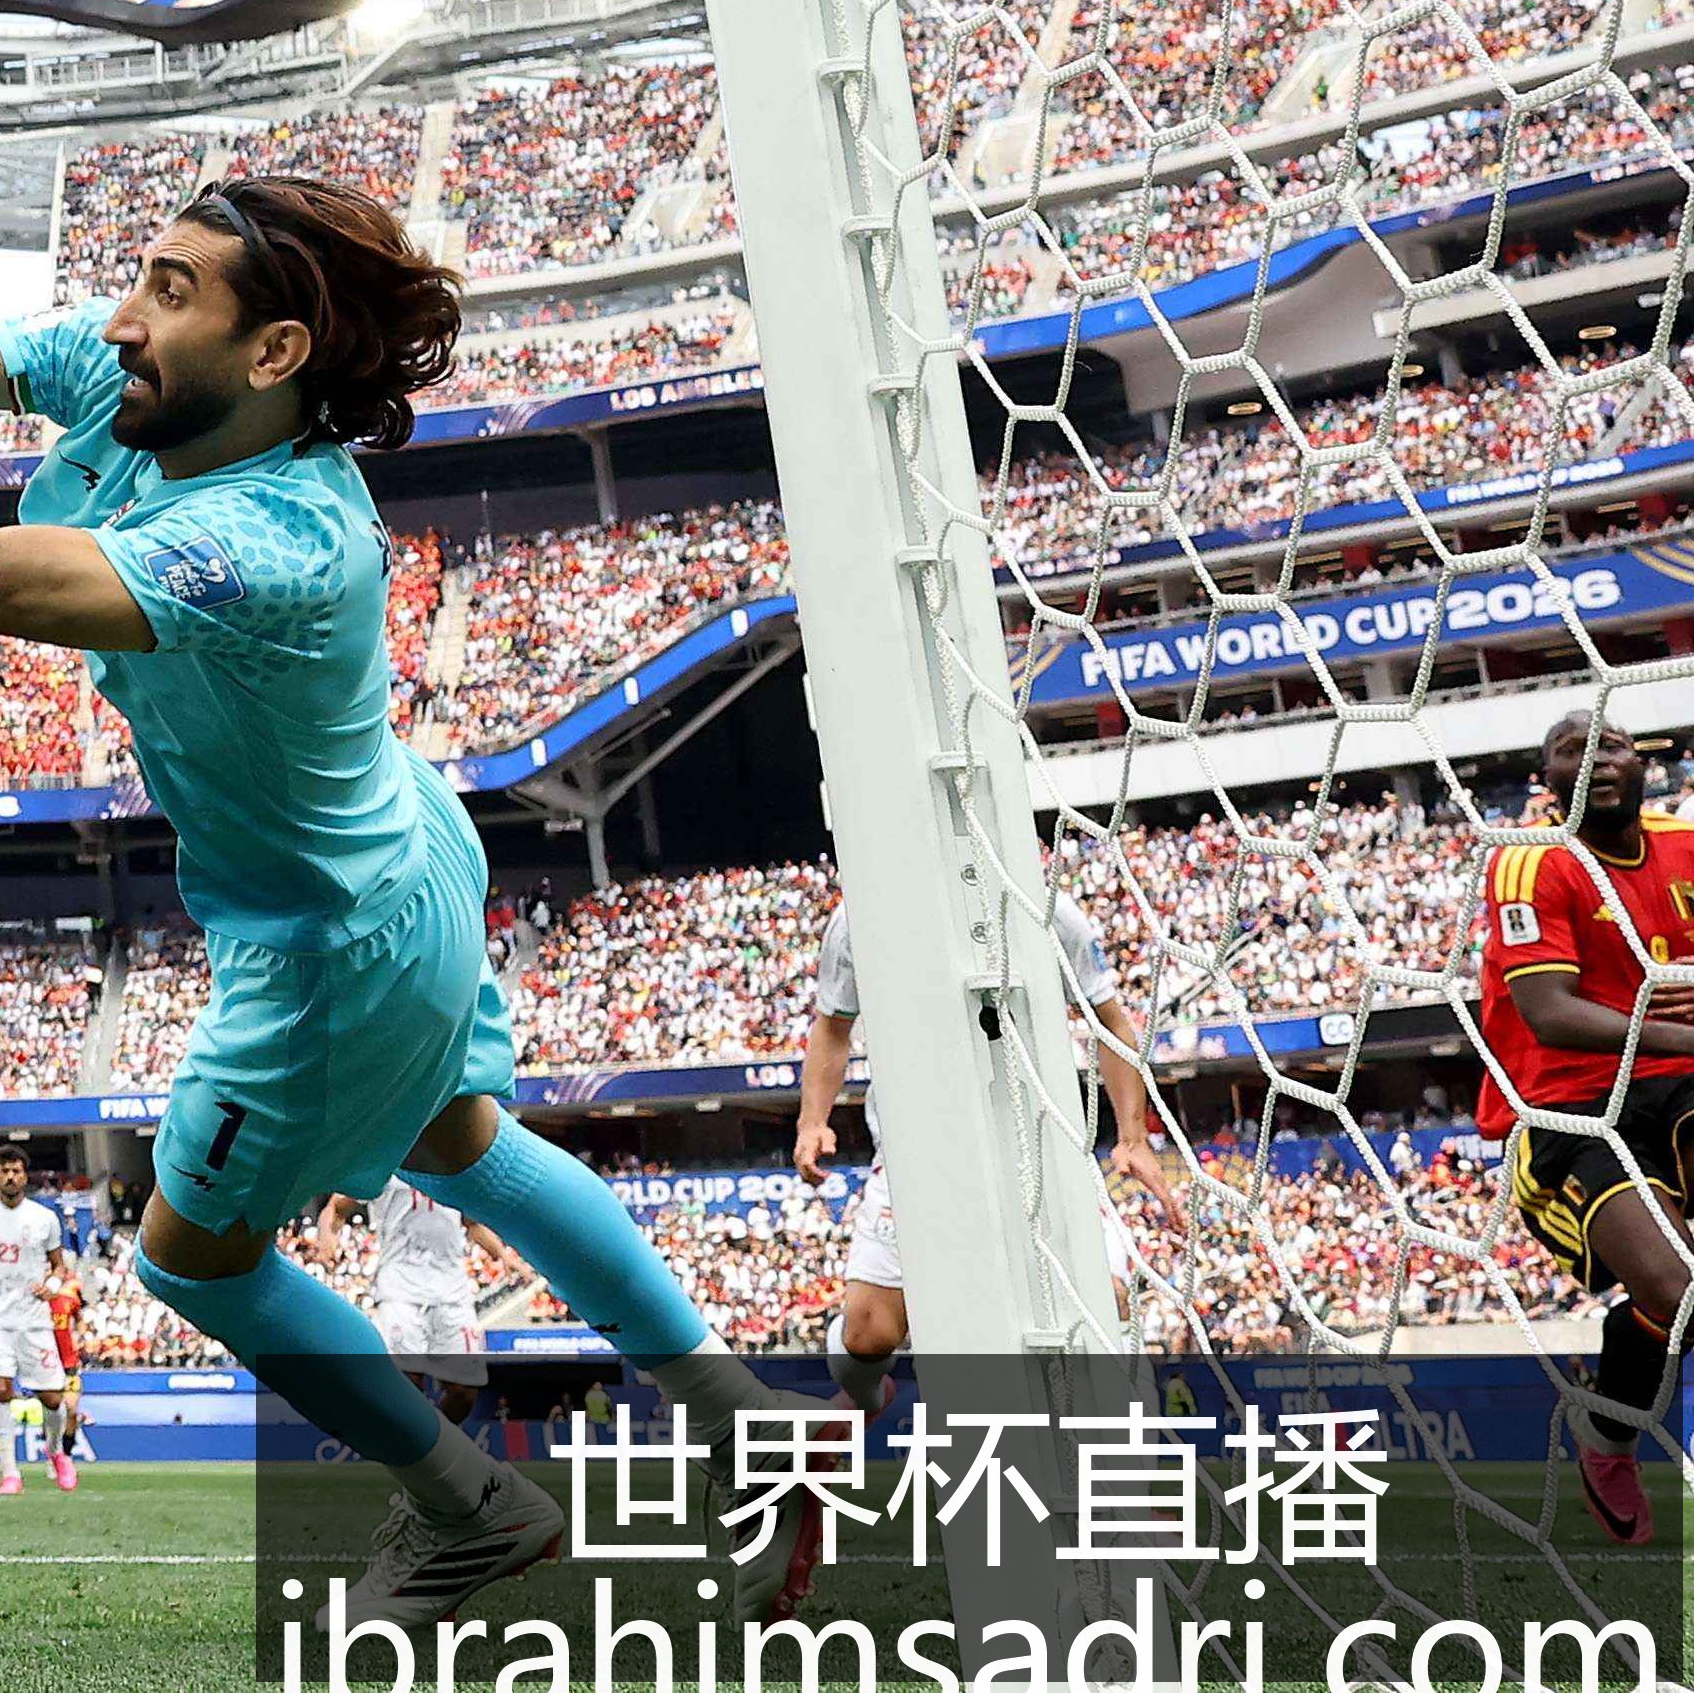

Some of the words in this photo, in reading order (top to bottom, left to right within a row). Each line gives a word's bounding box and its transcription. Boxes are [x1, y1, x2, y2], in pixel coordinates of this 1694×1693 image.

[610, 386, 657, 411] LOS
[1082, 643, 1177, 686] FIFA
[1176, 608, 1340, 672] WORLD
[1345, 597, 1440, 645] CUP
[1446, 569, 1621, 631] 2026
[745, 1066, 795, 1088] LOS
[674, 1177, 735, 1203] CUP
